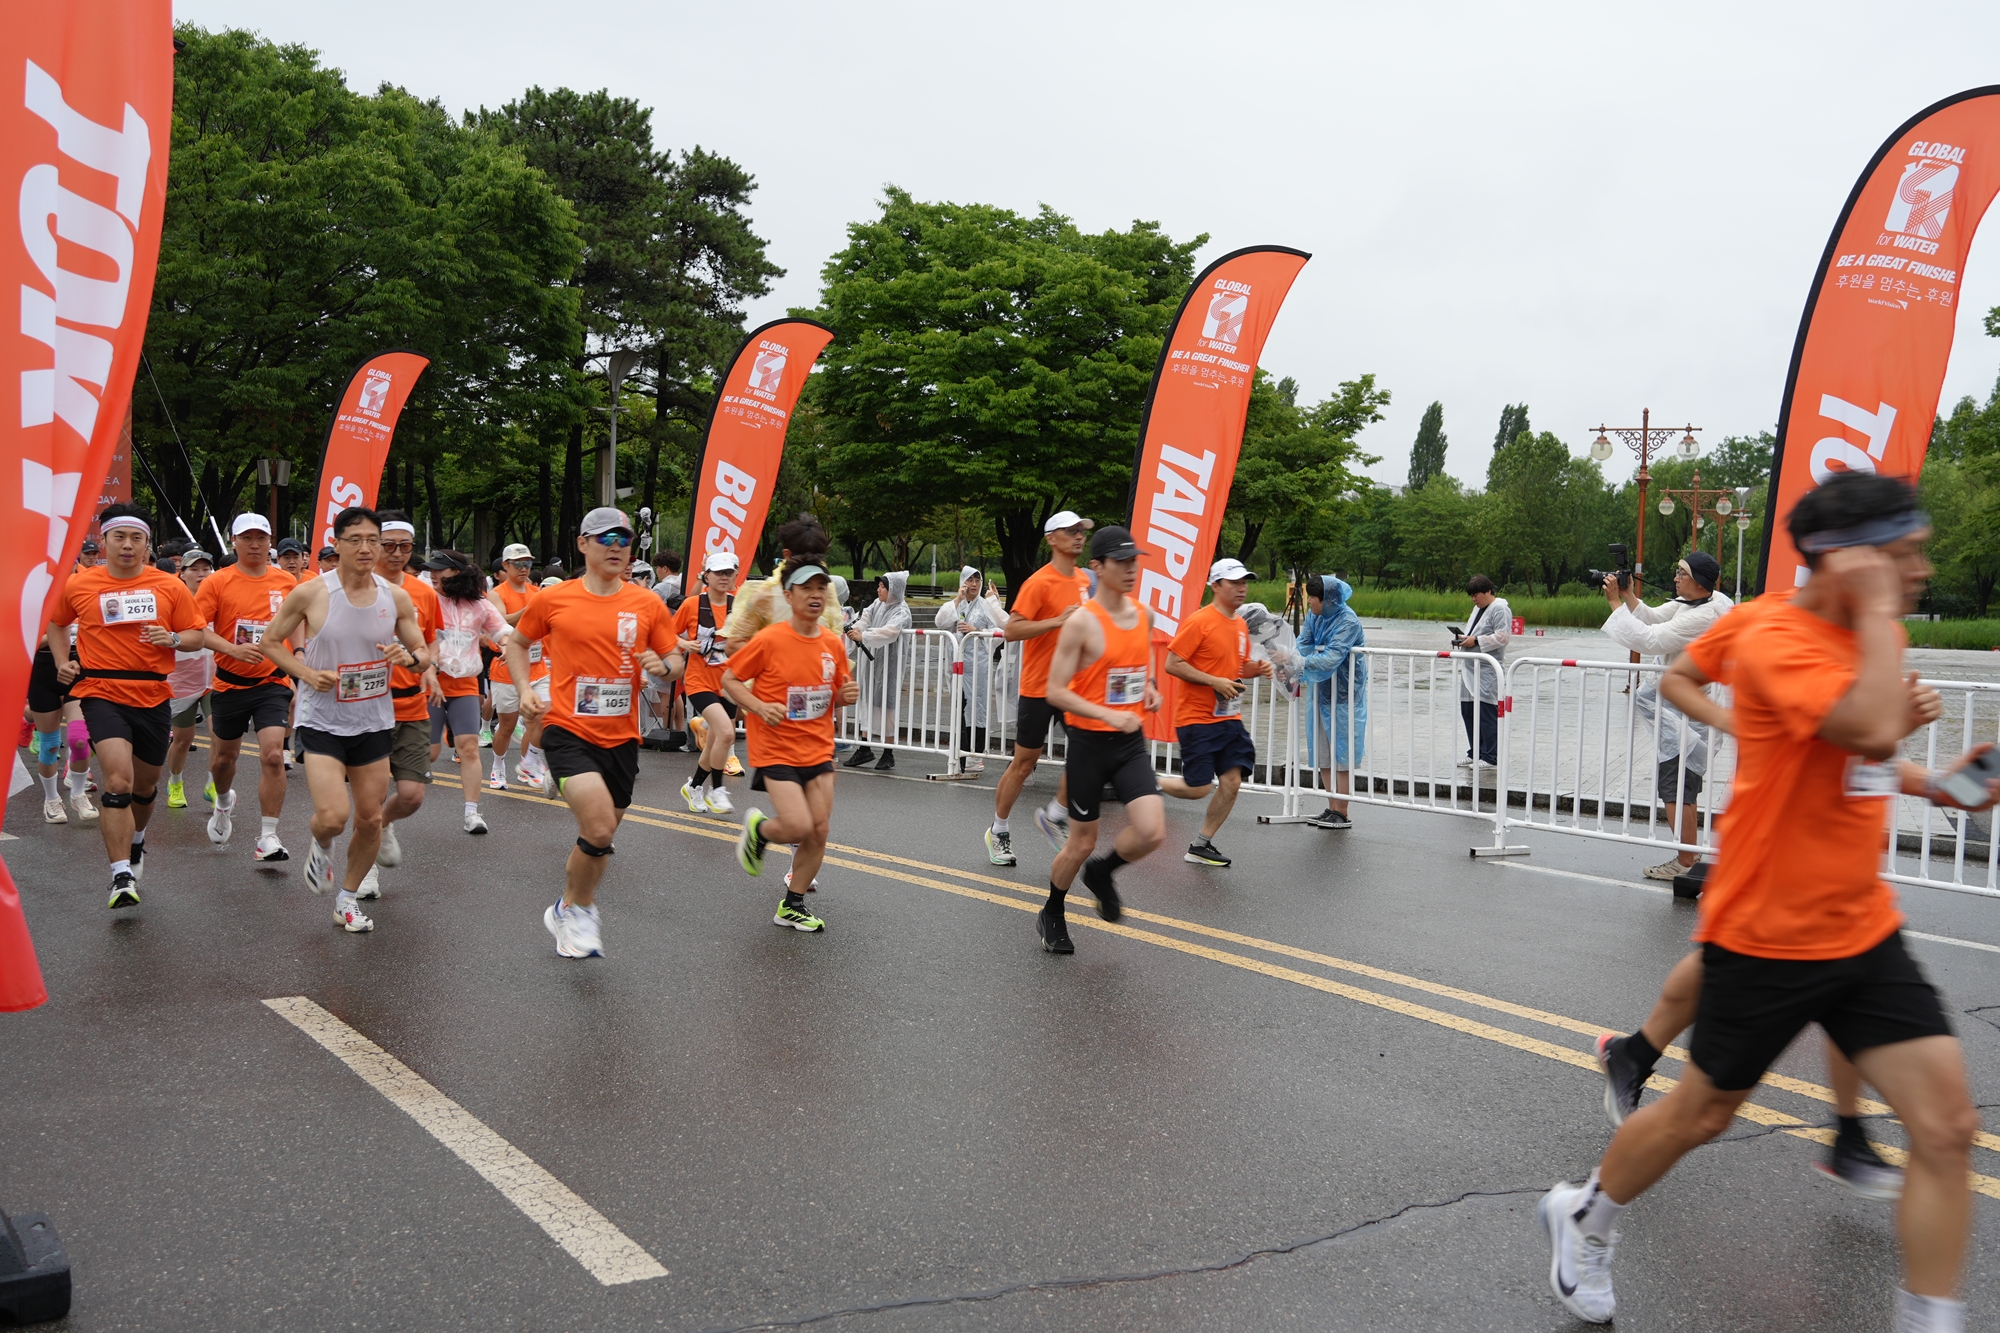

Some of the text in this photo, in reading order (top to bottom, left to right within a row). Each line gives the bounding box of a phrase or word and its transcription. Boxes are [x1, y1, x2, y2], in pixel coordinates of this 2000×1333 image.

[1907, 140, 1966, 164] GLOBAL
[1876, 232, 1940, 256] for WATER
[1836, 254, 1957, 284] BE A GREAT FINISHE
[1214, 278, 1252, 296] GLOBAL
[1835, 273, 1954, 308] 후원을 멈추는. 후원
[1868, 297, 1901, 310] World Vision
[759, 340, 790, 357] GLOBAL
[1197, 338, 1238, 355] for WATER
[1171, 350, 1251, 374] BE A GREAT FINISHER
[367, 368, 392, 382] GLOBAL
[1171, 363, 1199, 376] 후원을
[1229, 375, 1245, 388] 후원
[723, 395, 733, 403] BE
[740, 397, 761, 409] GREAT
[744, 386, 777, 402] for WATER
[363, 408, 381, 419] WATER
[723, 405, 745, 417] 후원을
[769, 418, 783, 430] 후원
[352, 416, 369, 425] GREAT
[368, 420, 391, 433] FINISHER
[704, 459, 757, 556] BUS
[1138, 443, 1217, 638] TAIPEI
[127, 605, 154, 614] 2676
